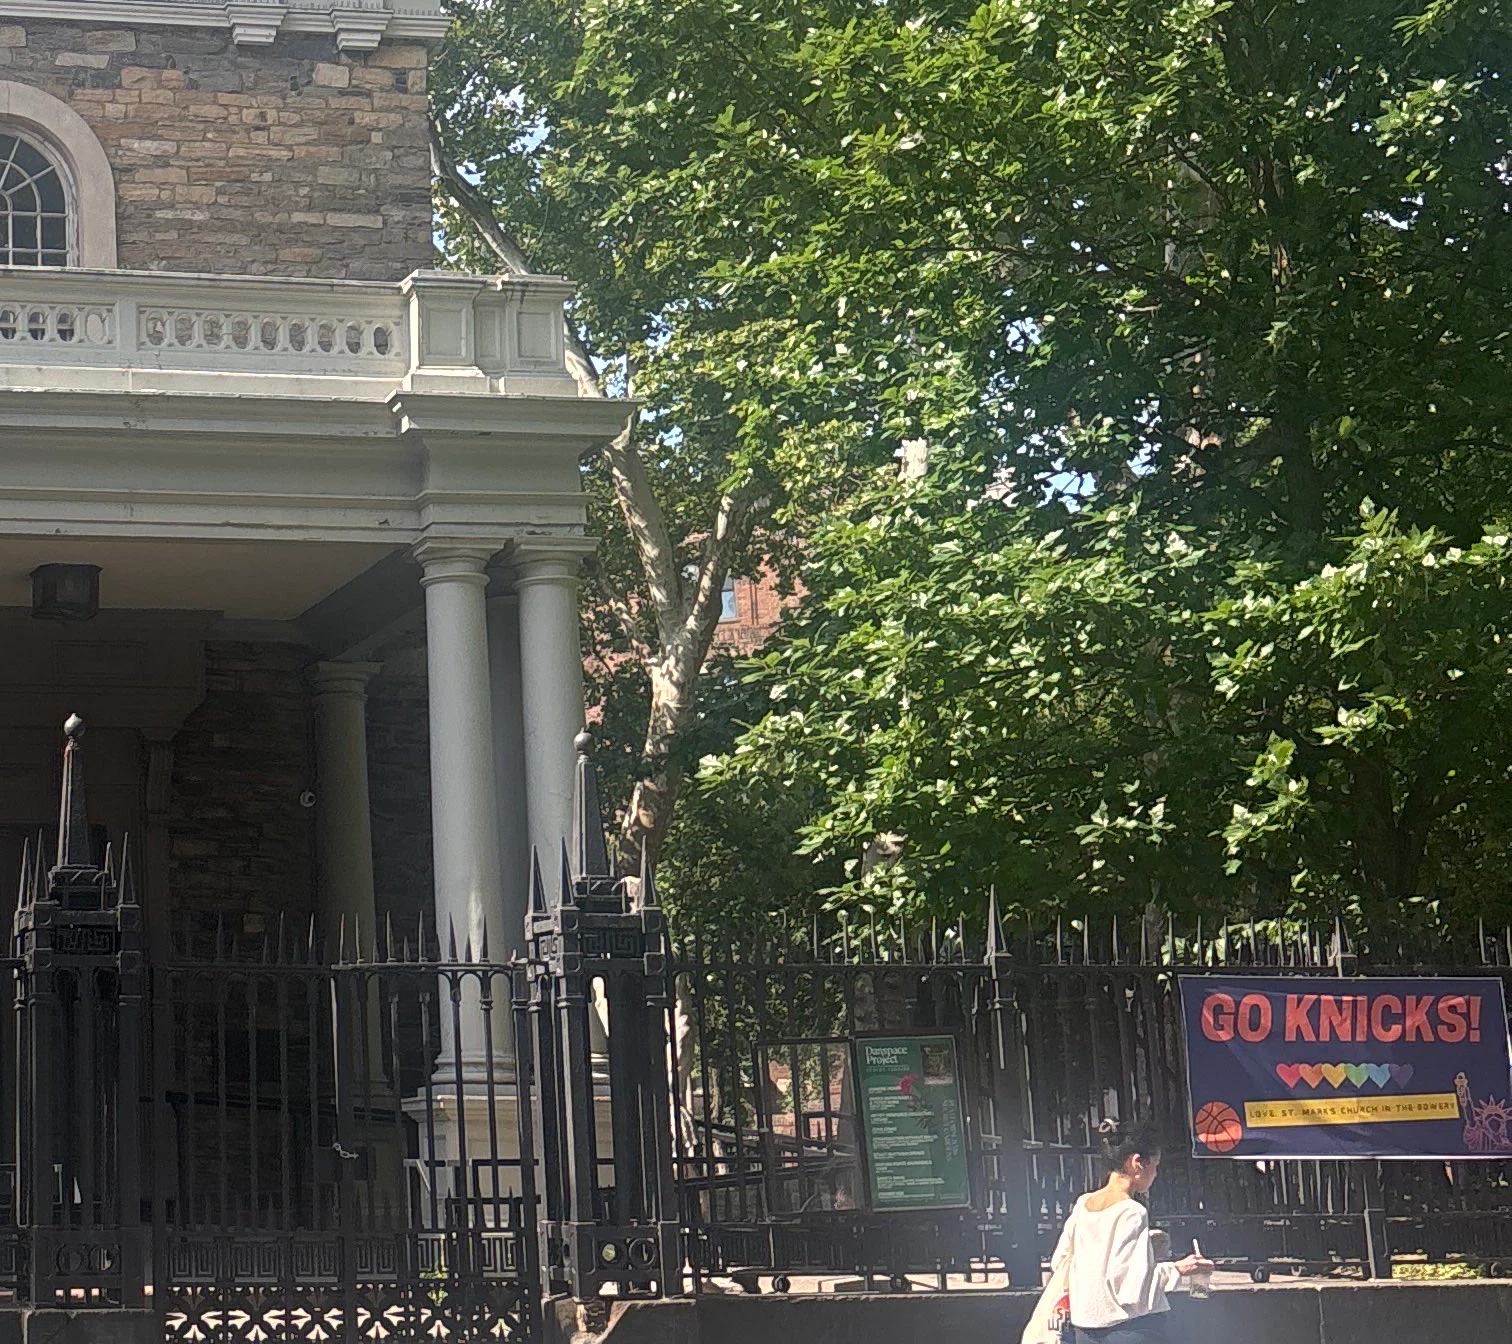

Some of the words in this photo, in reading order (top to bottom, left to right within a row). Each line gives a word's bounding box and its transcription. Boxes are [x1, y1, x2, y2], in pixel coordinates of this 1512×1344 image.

[1200, 992, 1273, 1043] GO
[1284, 993, 1483, 1044] KNICKS!
[865, 1046, 908, 1056] Danspace
[866, 1055, 899, 1065] Project
[1340, 1106, 1378, 1115] CHURCH
[1381, 1105, 1391, 1113] IN
[1396, 1104, 1413, 1113] THE
[1417, 1102, 1455, 1112] BOWERY
